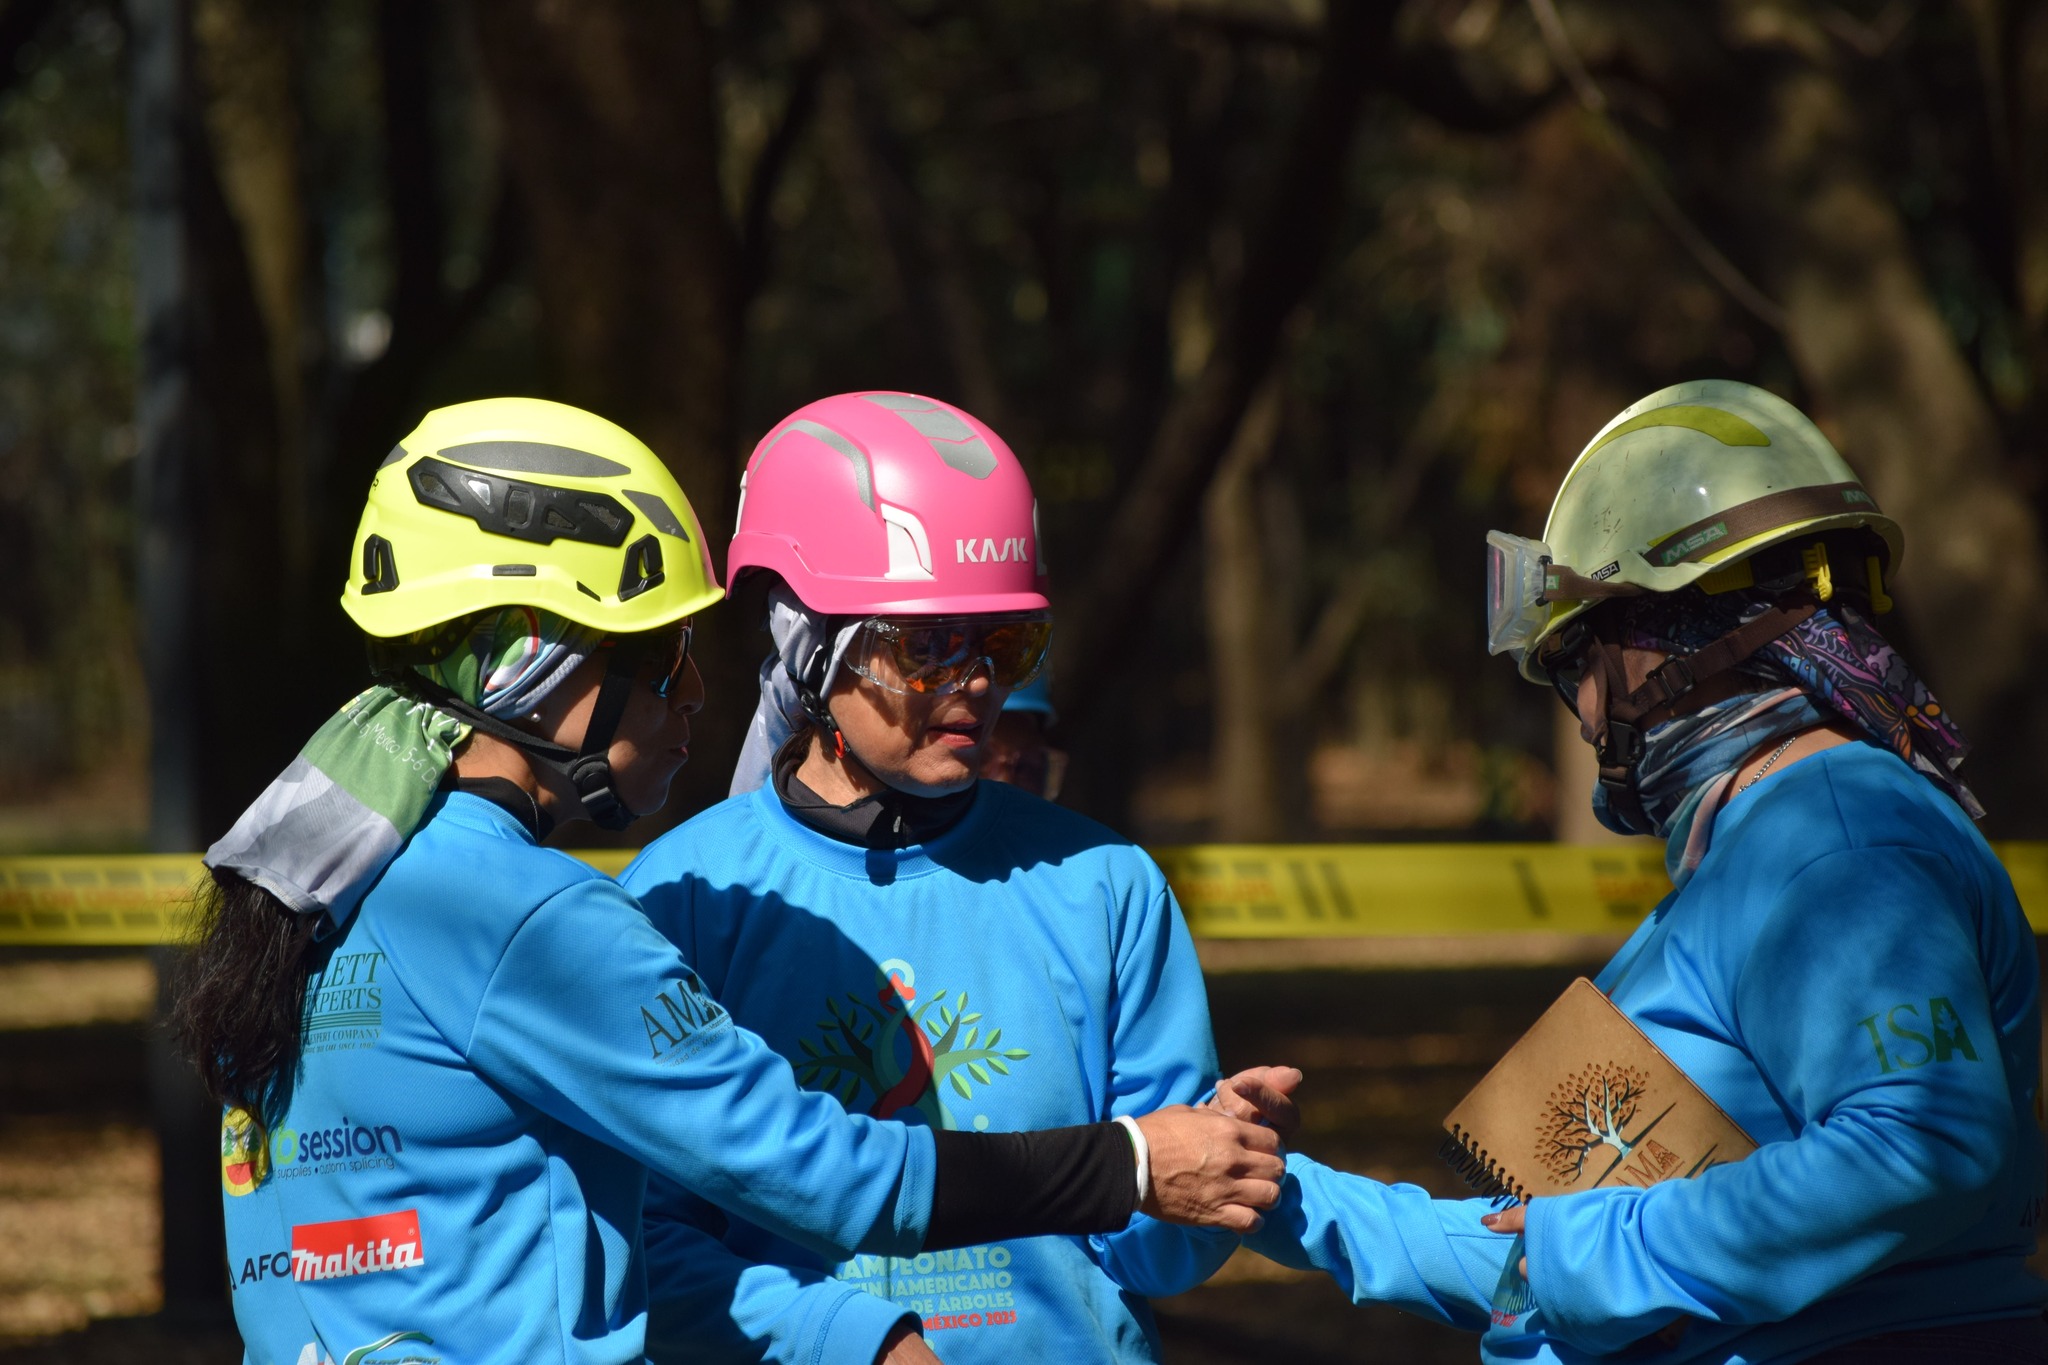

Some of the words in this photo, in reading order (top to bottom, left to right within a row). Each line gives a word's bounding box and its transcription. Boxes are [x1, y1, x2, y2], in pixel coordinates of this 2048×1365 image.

[956, 537, 1028, 564] KASK
[1664, 525, 1726, 566] MSA
[1591, 562, 1620, 582] MSA
[332, 1027, 381, 1041] COMPANY
[1857, 996, 1983, 1075] ISA
[277, 1166, 312, 1180] supplies
[350, 1155, 396, 1173] splicing
[835, 1246, 1011, 1281] AMPEONATO
[910, 1299, 934, 1315] DE
[938, 1291, 1014, 1312] ÁRBOLES
[922, 1312, 983, 1332] MÉXICO
[986, 1310, 1018, 1326] 2025
